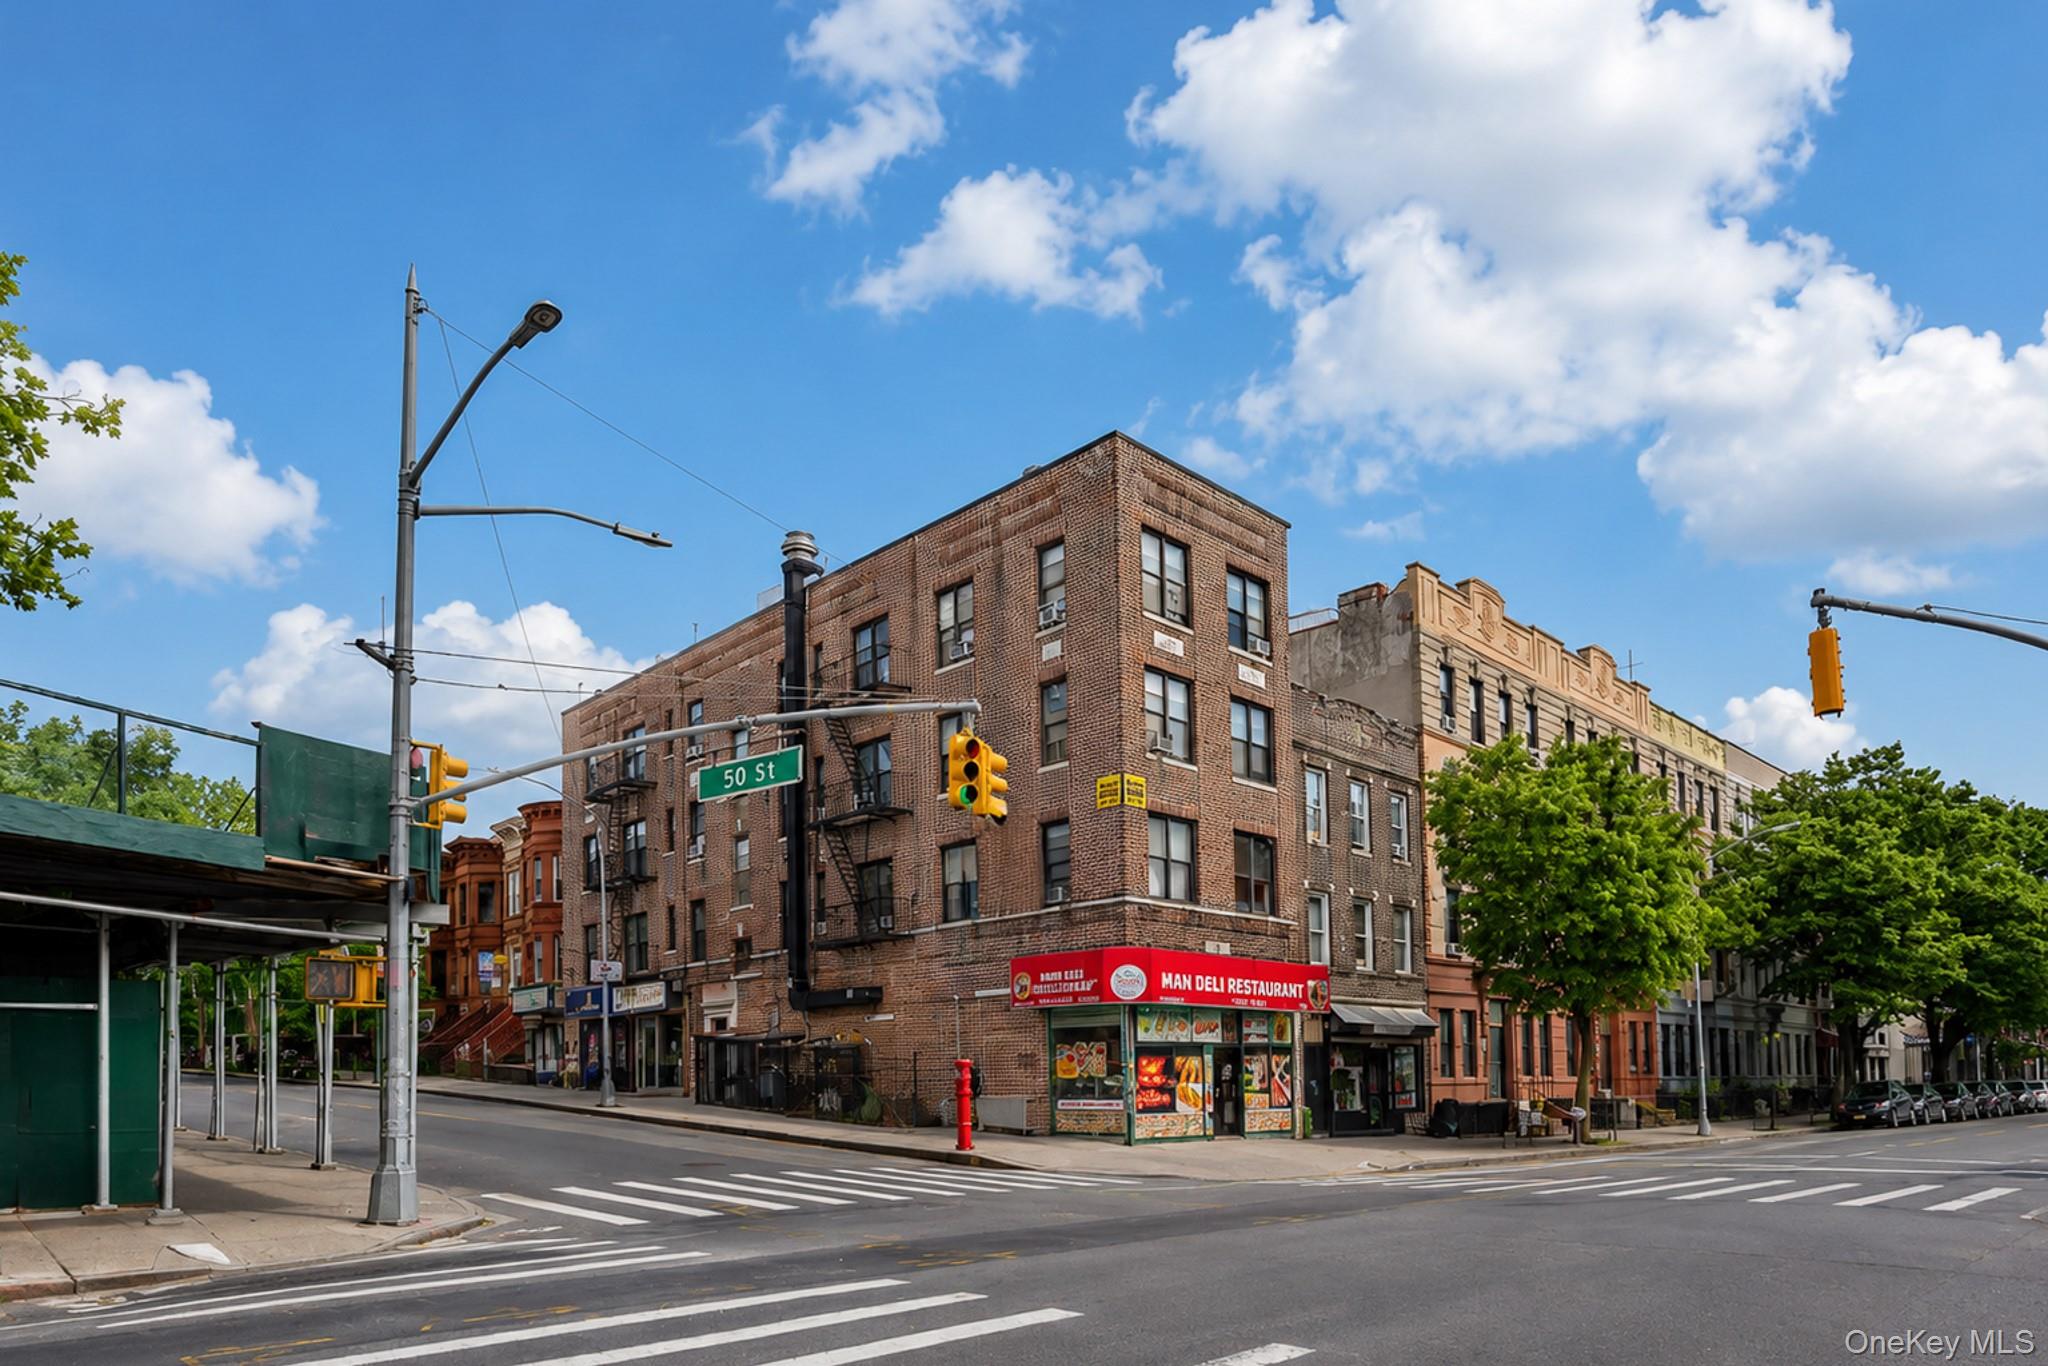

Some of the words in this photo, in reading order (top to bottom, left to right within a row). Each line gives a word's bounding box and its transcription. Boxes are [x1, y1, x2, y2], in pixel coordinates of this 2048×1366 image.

[723, 767, 746, 789] 50
[755, 762, 775, 782] St
[1161, 971, 1193, 991] MAN
[1195, 975, 1225, 993] DELI
[1227, 977, 1304, 999] RESTAURANT
